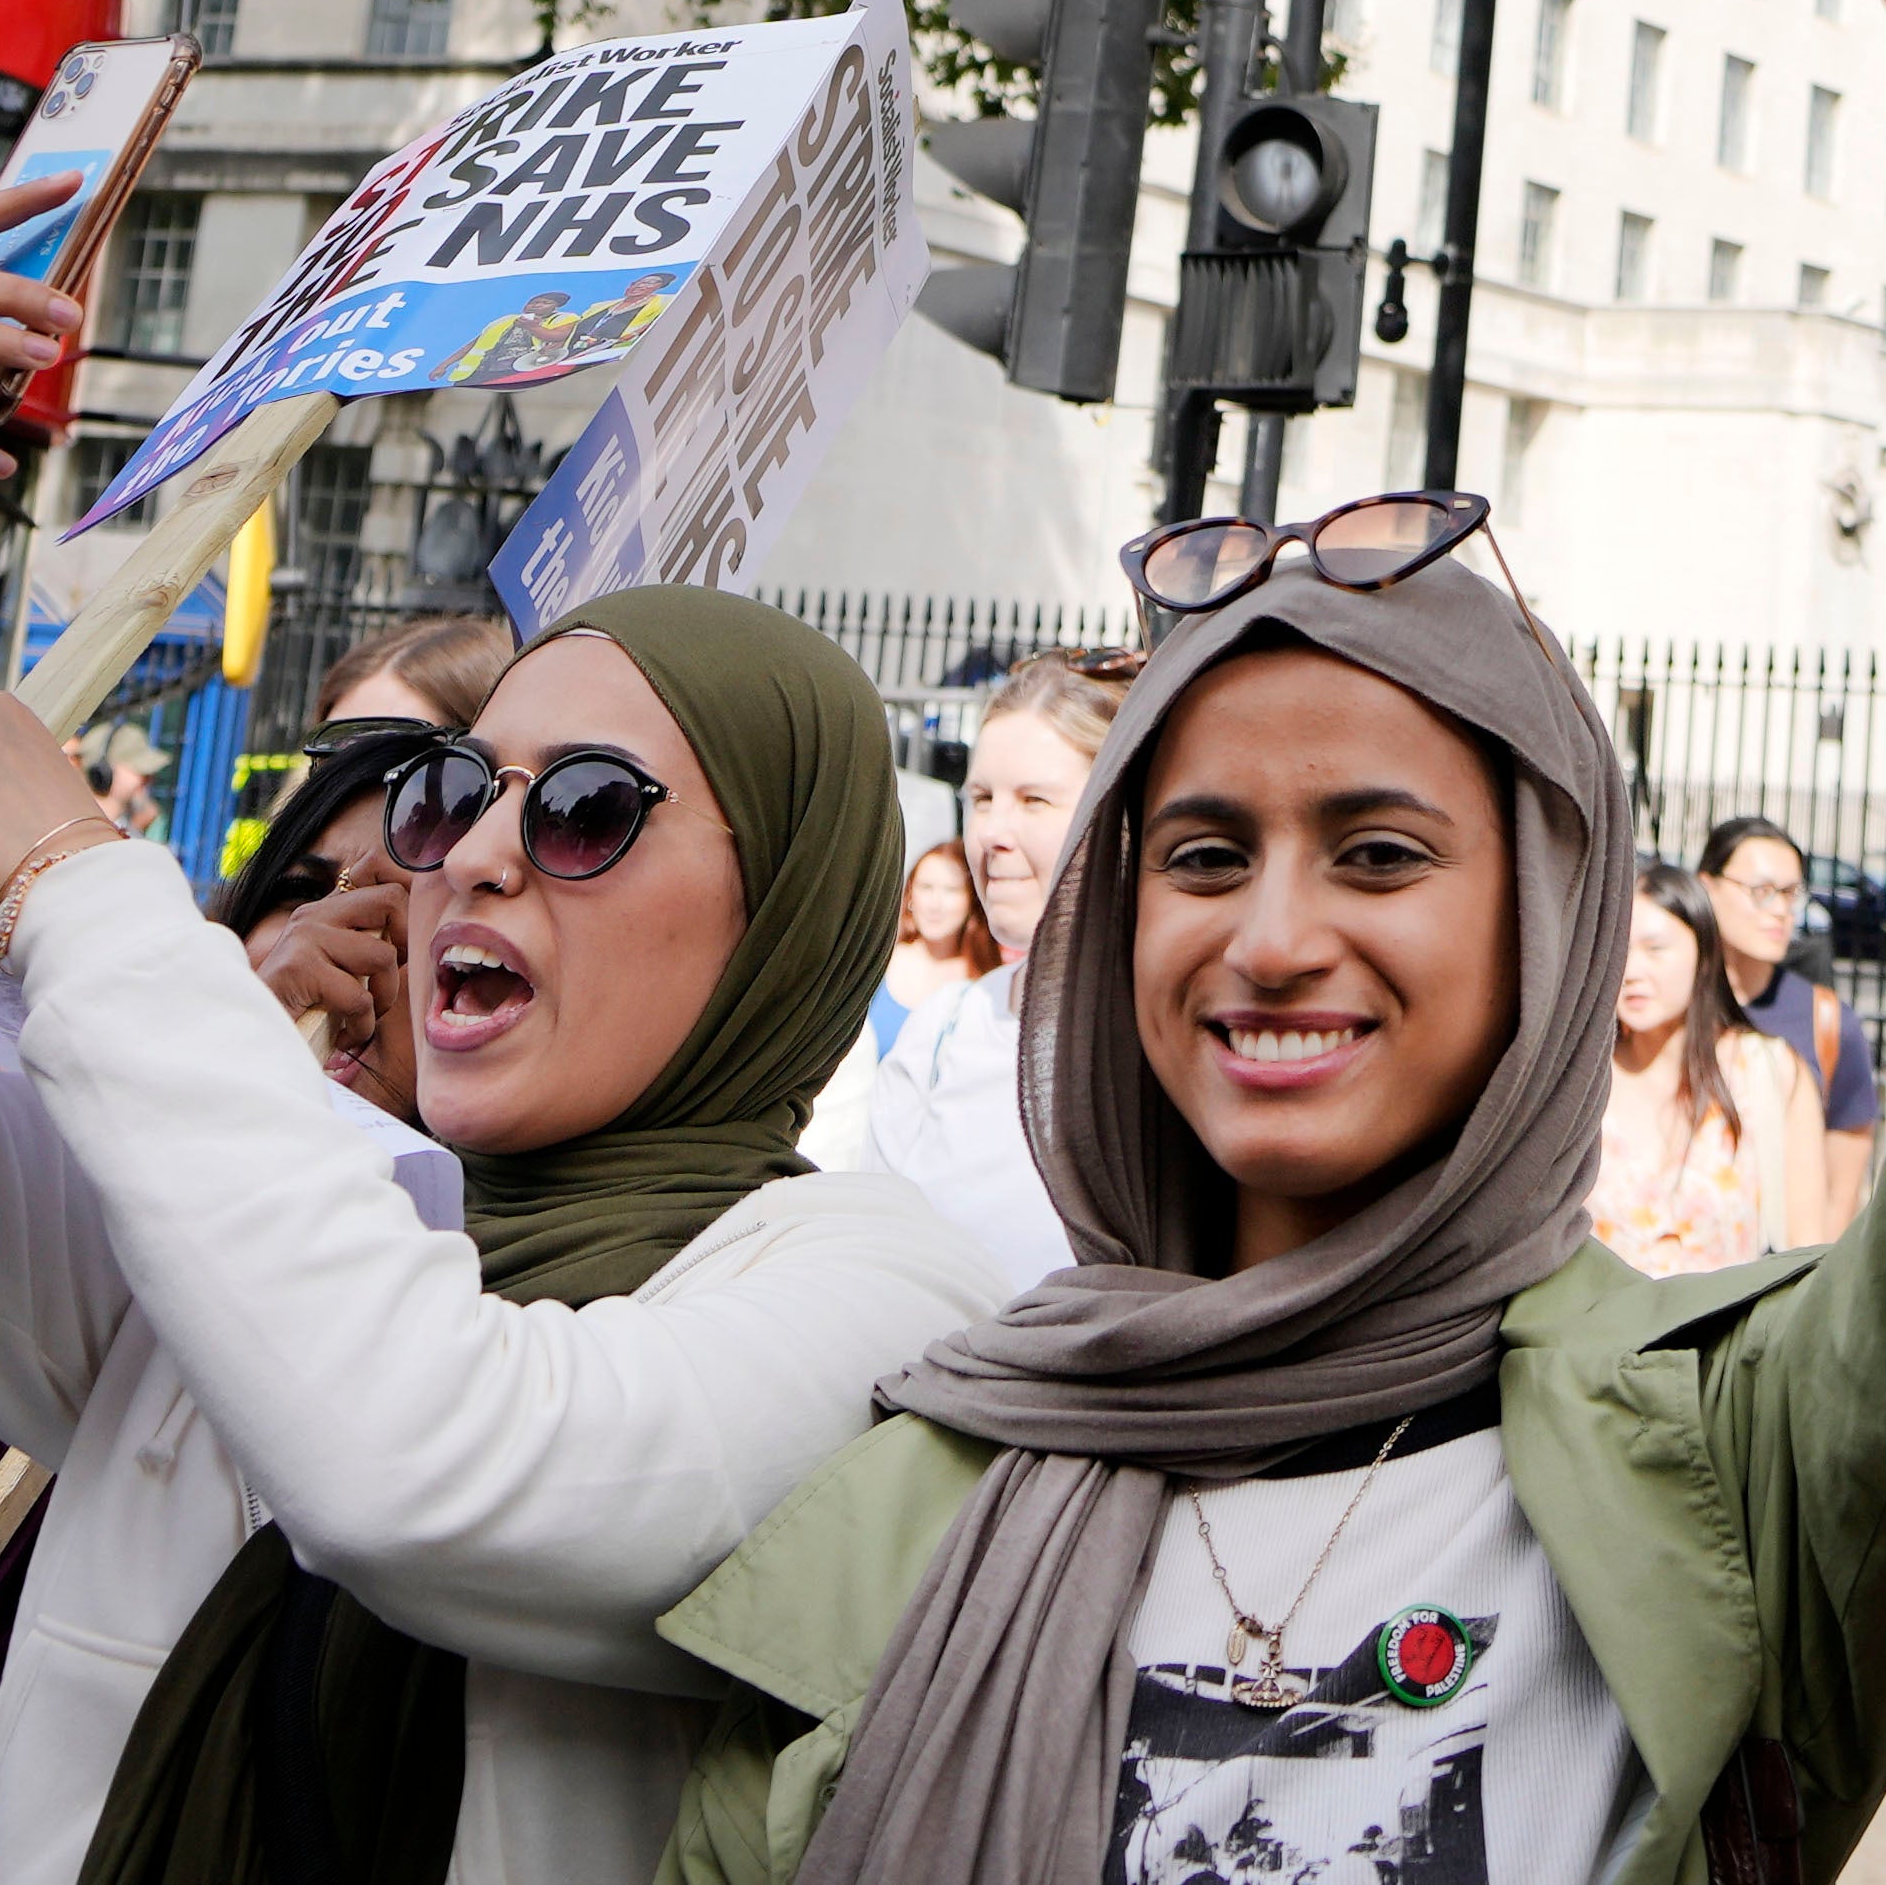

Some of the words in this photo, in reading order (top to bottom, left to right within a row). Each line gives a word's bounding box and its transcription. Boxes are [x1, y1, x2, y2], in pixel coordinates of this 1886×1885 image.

[599, 40, 743, 65] Worker
[325, 61, 727, 241] STRIKE
[423, 120, 746, 210] SAVE
[425, 188, 712, 269] NHS
[723, 145, 802, 328] TO
[798, 43, 877, 370] STRIKE
[288, 292, 406, 355] out
[224, 338, 426, 425] Tories
[732, 273, 817, 520] SAVE
[521, 517, 574, 628] the
[1387, 1618, 1412, 1683] FREEDOM
[1412, 1610, 1439, 1625] FOR
[1426, 1643, 1466, 1697] PALESTINE
